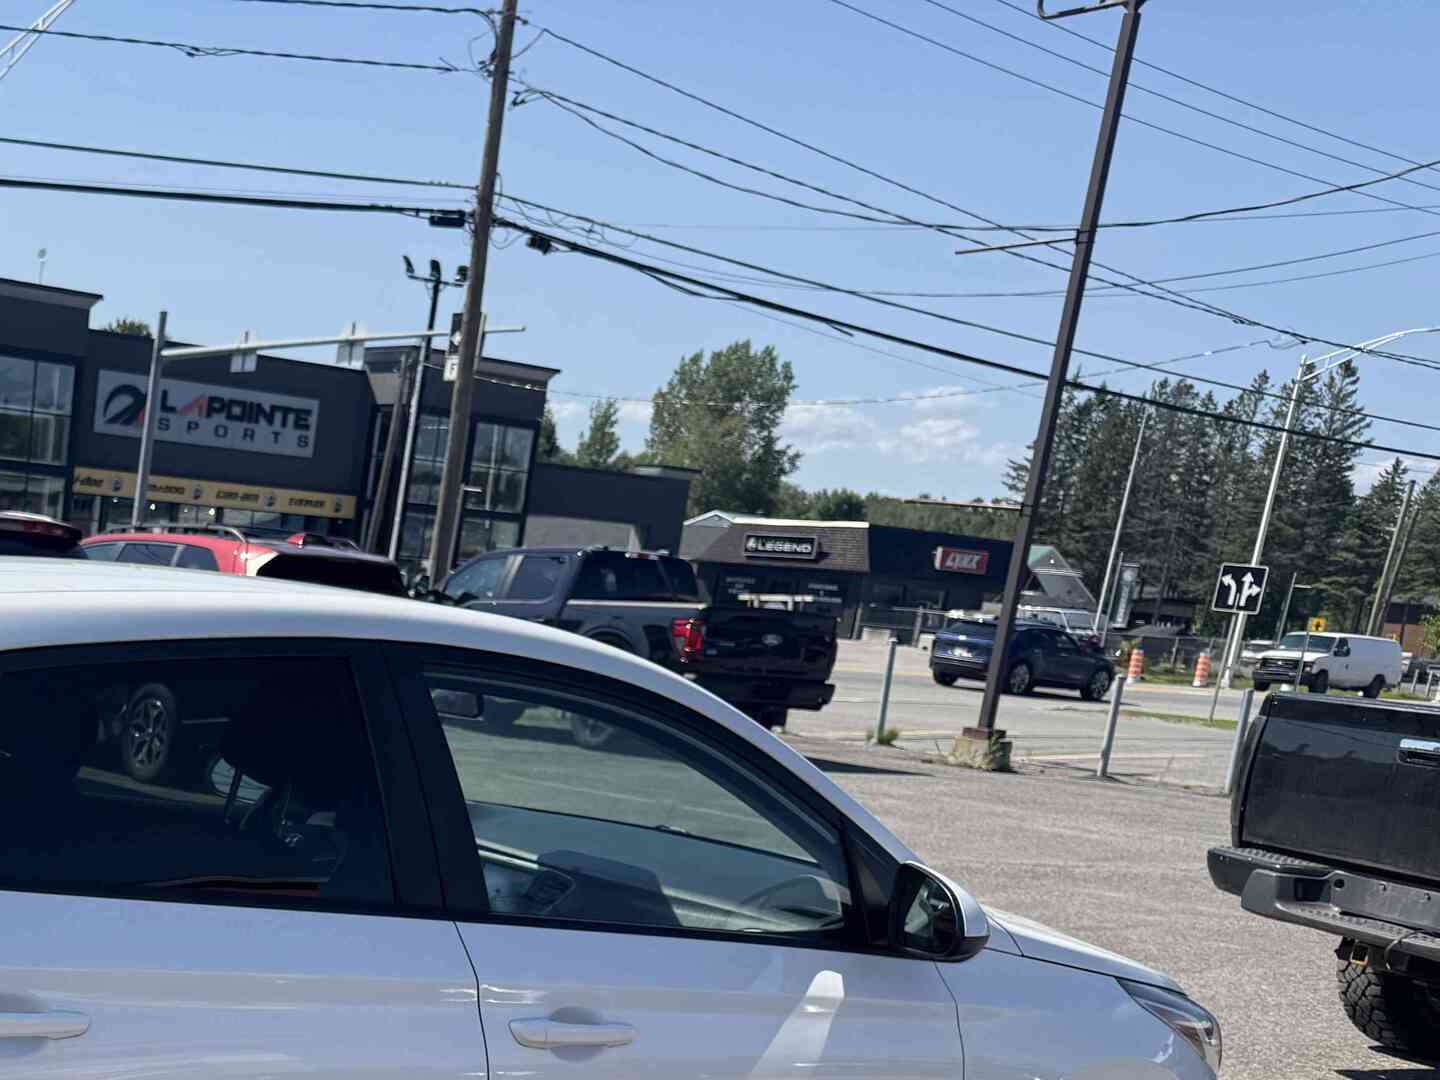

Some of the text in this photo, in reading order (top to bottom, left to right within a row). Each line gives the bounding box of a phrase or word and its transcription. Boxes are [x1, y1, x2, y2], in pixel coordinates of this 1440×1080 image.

[160, 388, 313, 432] LAPOINTE
[157, 417, 310, 449] SPORTS
[757, 539, 812, 554] LEGEND
